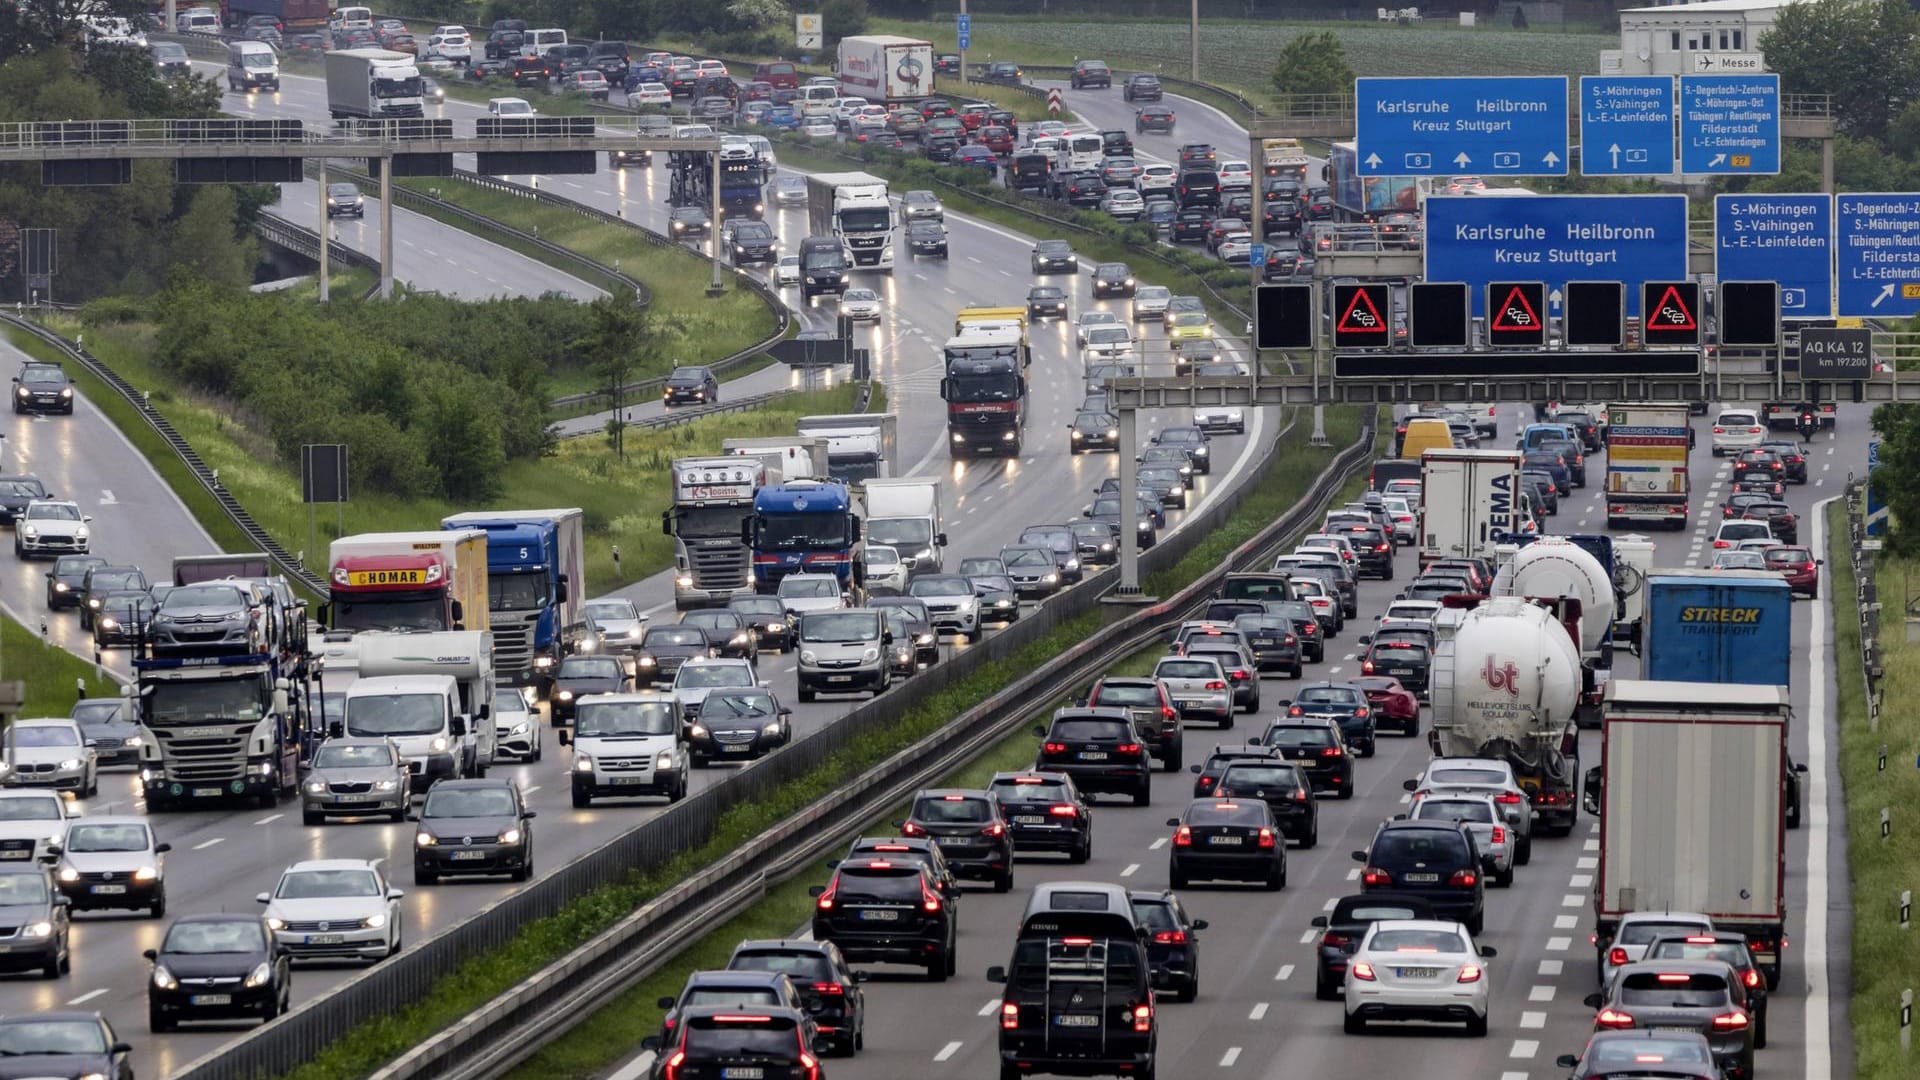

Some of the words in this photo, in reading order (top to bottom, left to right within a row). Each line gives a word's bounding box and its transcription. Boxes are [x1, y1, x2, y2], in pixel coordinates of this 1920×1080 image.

[1721, 58, 1756, 68] Messe
[1592, 85, 1662, 96] S.-Möhringen
[1377, 100, 1449, 113] Karlsruhe
[1476, 99, 1547, 112] Heilbronn
[1595, 98, 1660, 110] S.-Vaihingen
[1695, 98, 1765, 110] S.-Möhringen-Ost
[1588, 111, 1668, 122] L.-E.-Leinfelden
[1413, 120, 1449, 131] Kreuz
[1456, 119, 1512, 134] Stuttgart
[1701, 124, 1759, 134] Filderstadt
[1693, 137, 1767, 149] L.-E.-Echterdingen
[1415, 155, 1422, 166] 8
[1503, 155, 1510, 166] 8
[1735, 157, 1746, 166] 27
[1731, 203, 1817, 216] S.-Möhringen
[1456, 224, 1546, 240] Karlsruhe
[1567, 224, 1655, 240] Heilbronn
[1734, 219, 1814, 233] S.-Vaihingen
[1722, 236, 1825, 248] L.-E.-Leinfelden
[1495, 249, 1541, 263] Kreuz
[1548, 249, 1617, 265] Stuttgart
[1862, 251, 1920, 263] Fildersta
[1908, 286, 1920, 297] 27
[1785, 293, 1793, 304] 8
[1805, 342, 1824, 354] AQ
[1827, 342, 1846, 353] KA
[1851, 342, 1864, 353] 12
[1819, 358, 1834, 367] km
[1837, 358, 1868, 367] 197.200
[1615, 413, 1623, 424] d
[1489, 473, 1512, 542] PEMA
[519, 548, 528, 559] 5
[358, 571, 418, 585] CHOMAR
[1682, 607, 1760, 622] STRECK
